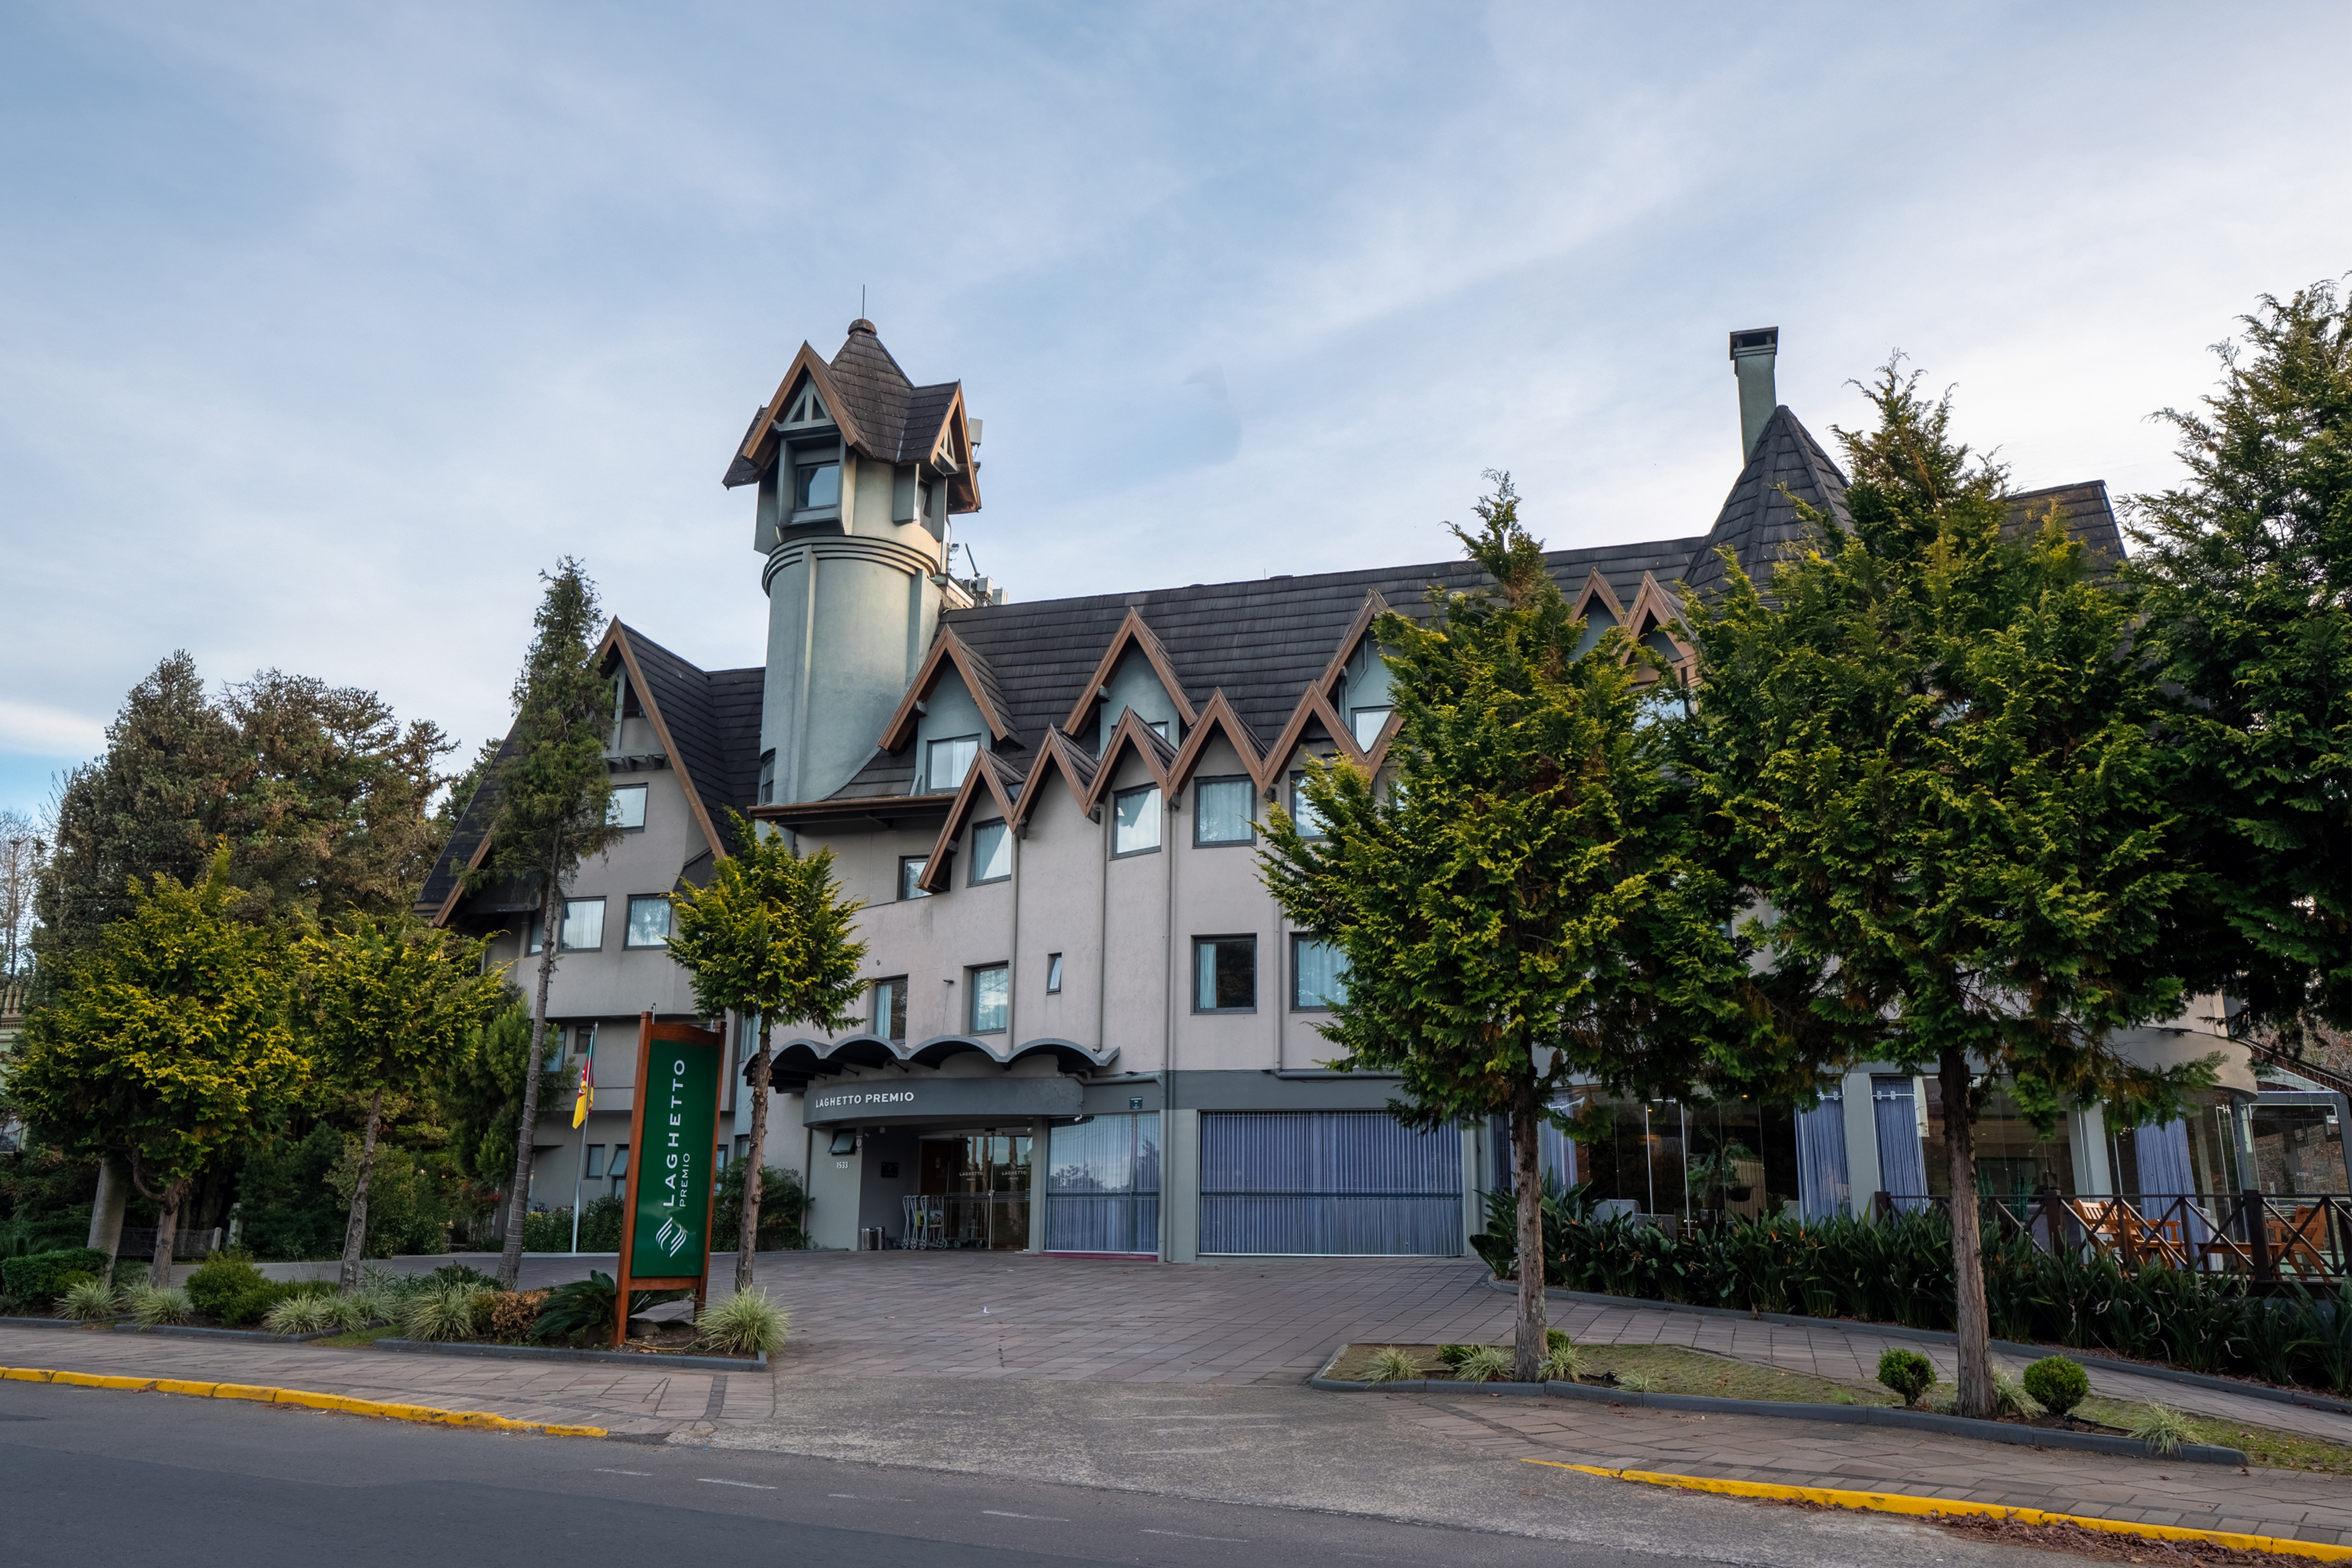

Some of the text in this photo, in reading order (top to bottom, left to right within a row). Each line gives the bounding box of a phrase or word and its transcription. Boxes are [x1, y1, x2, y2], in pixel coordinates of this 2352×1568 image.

[816, 1092, 914, 1108] LAGHETTO PREMIO
[663, 1059, 685, 1206] LAGHETTO
[680, 1153, 690, 1207] PREMIO
